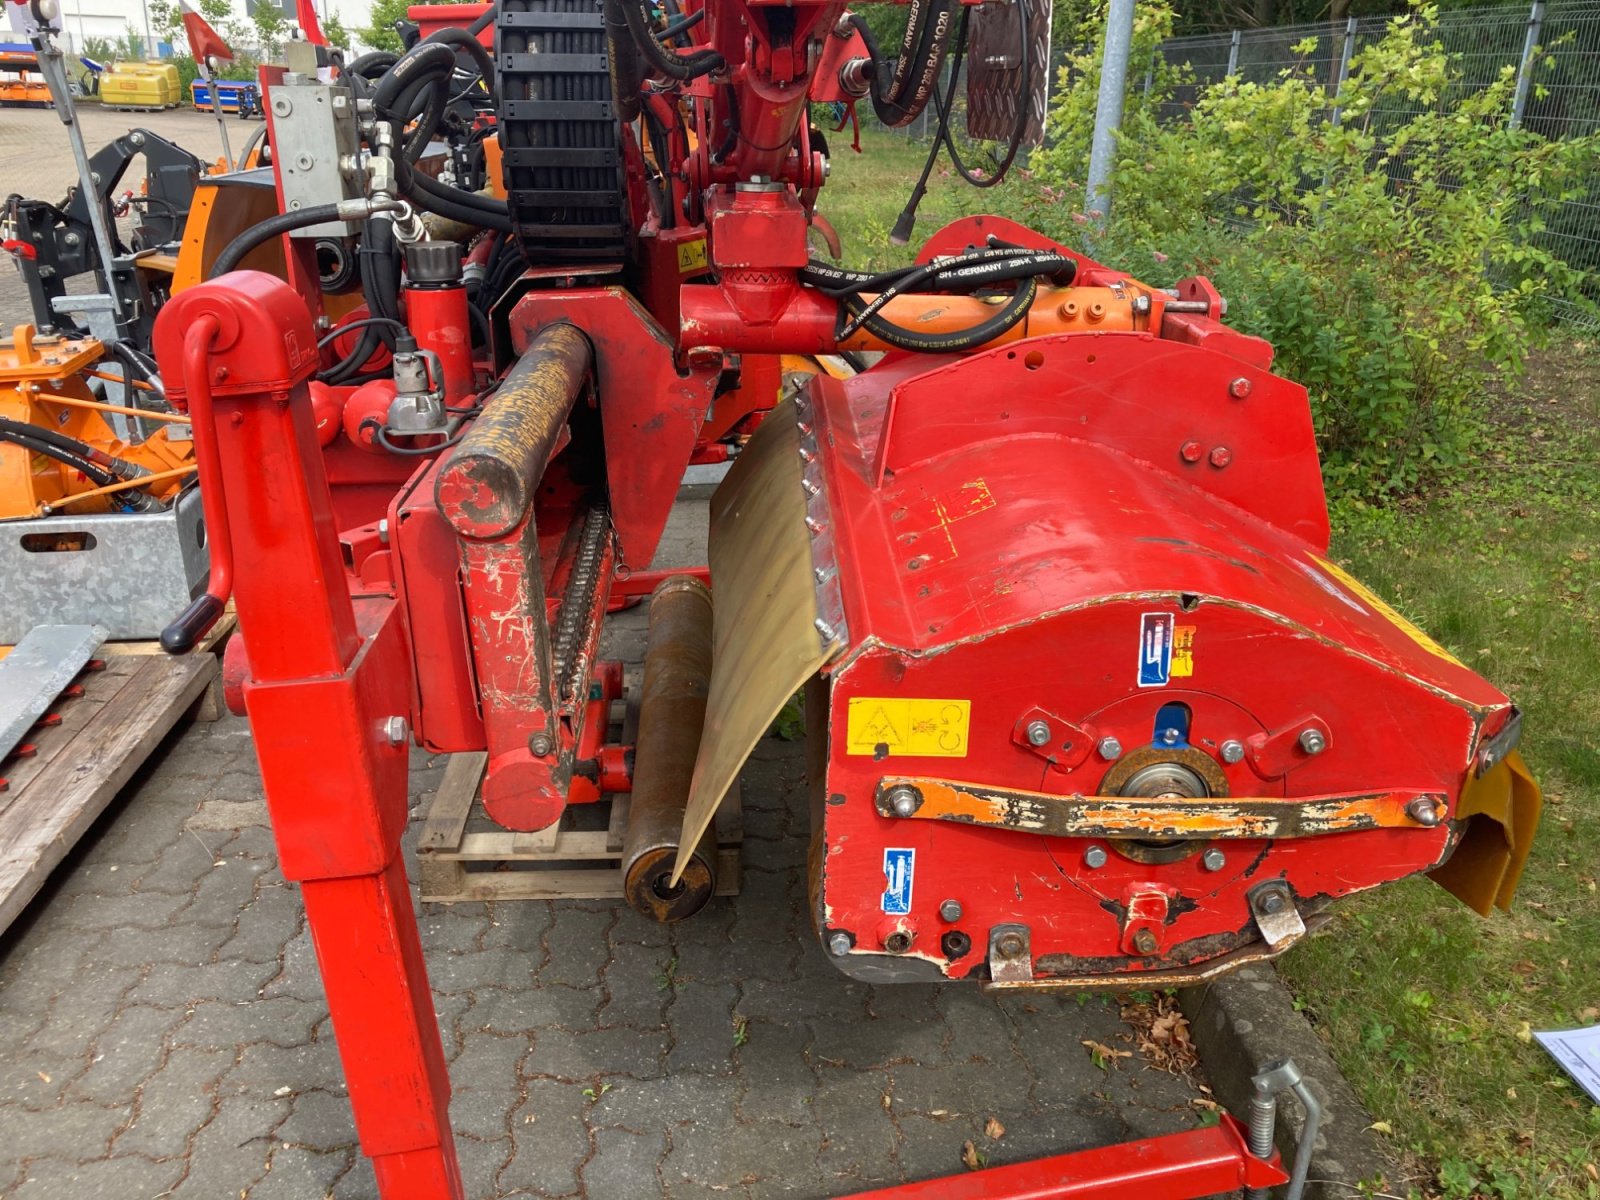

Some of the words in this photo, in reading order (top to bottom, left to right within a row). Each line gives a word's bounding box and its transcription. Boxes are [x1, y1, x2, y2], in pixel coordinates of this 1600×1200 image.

[904, 0, 920, 48] GERMANY
[939, 270, 952, 279] SH
[957, 262, 1002, 277] GERMANY
[885, 287, 897, 297] SH
[855, 297, 884, 325] GERMANY
